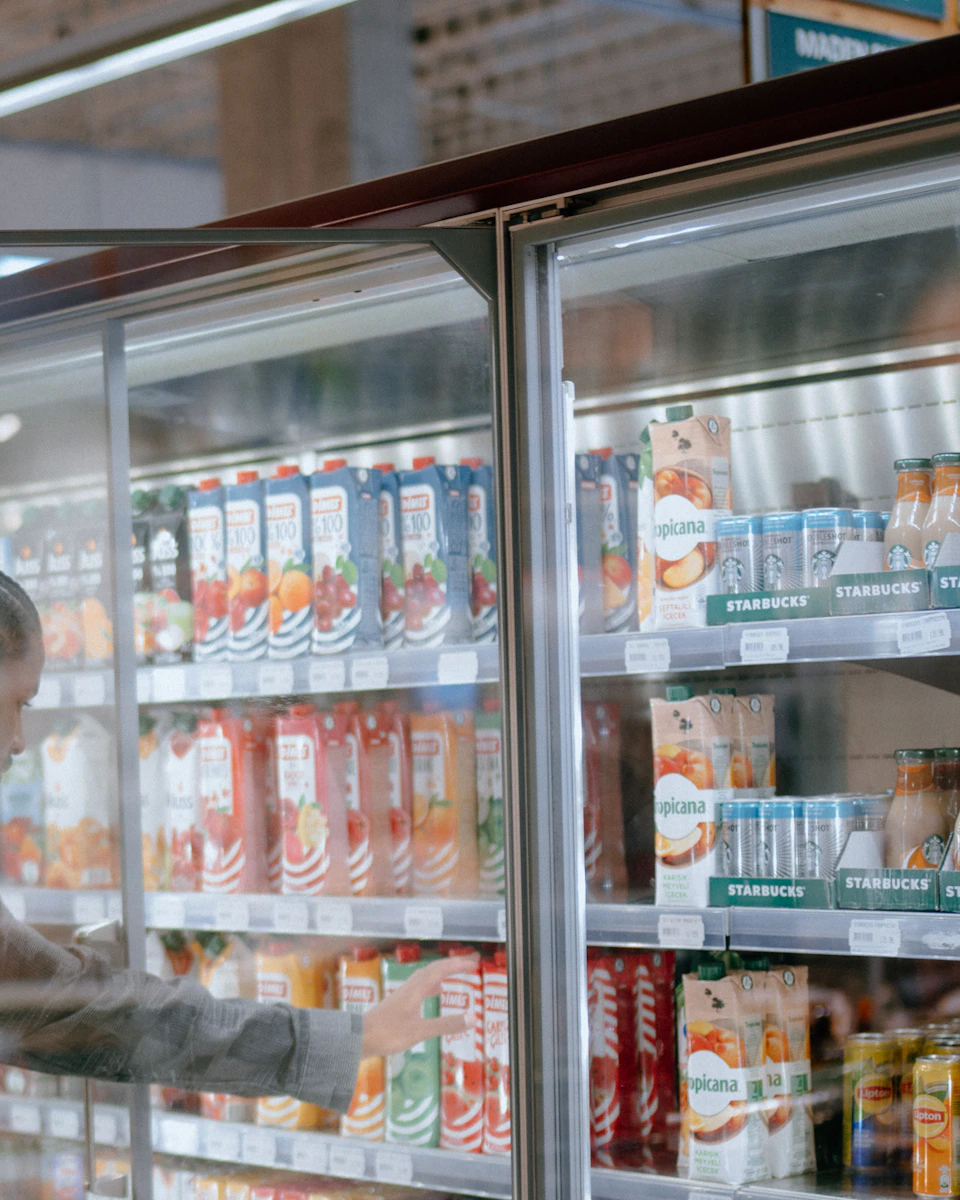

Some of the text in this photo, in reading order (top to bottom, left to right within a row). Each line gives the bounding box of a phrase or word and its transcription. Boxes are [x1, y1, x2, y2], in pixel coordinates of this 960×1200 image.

[836, 582, 921, 598] STARBUCKS
[727, 595, 808, 612] STARBUCKS
[728, 884, 805, 898] STARBUCKS
[846, 877, 930, 890] STARBUCKS
